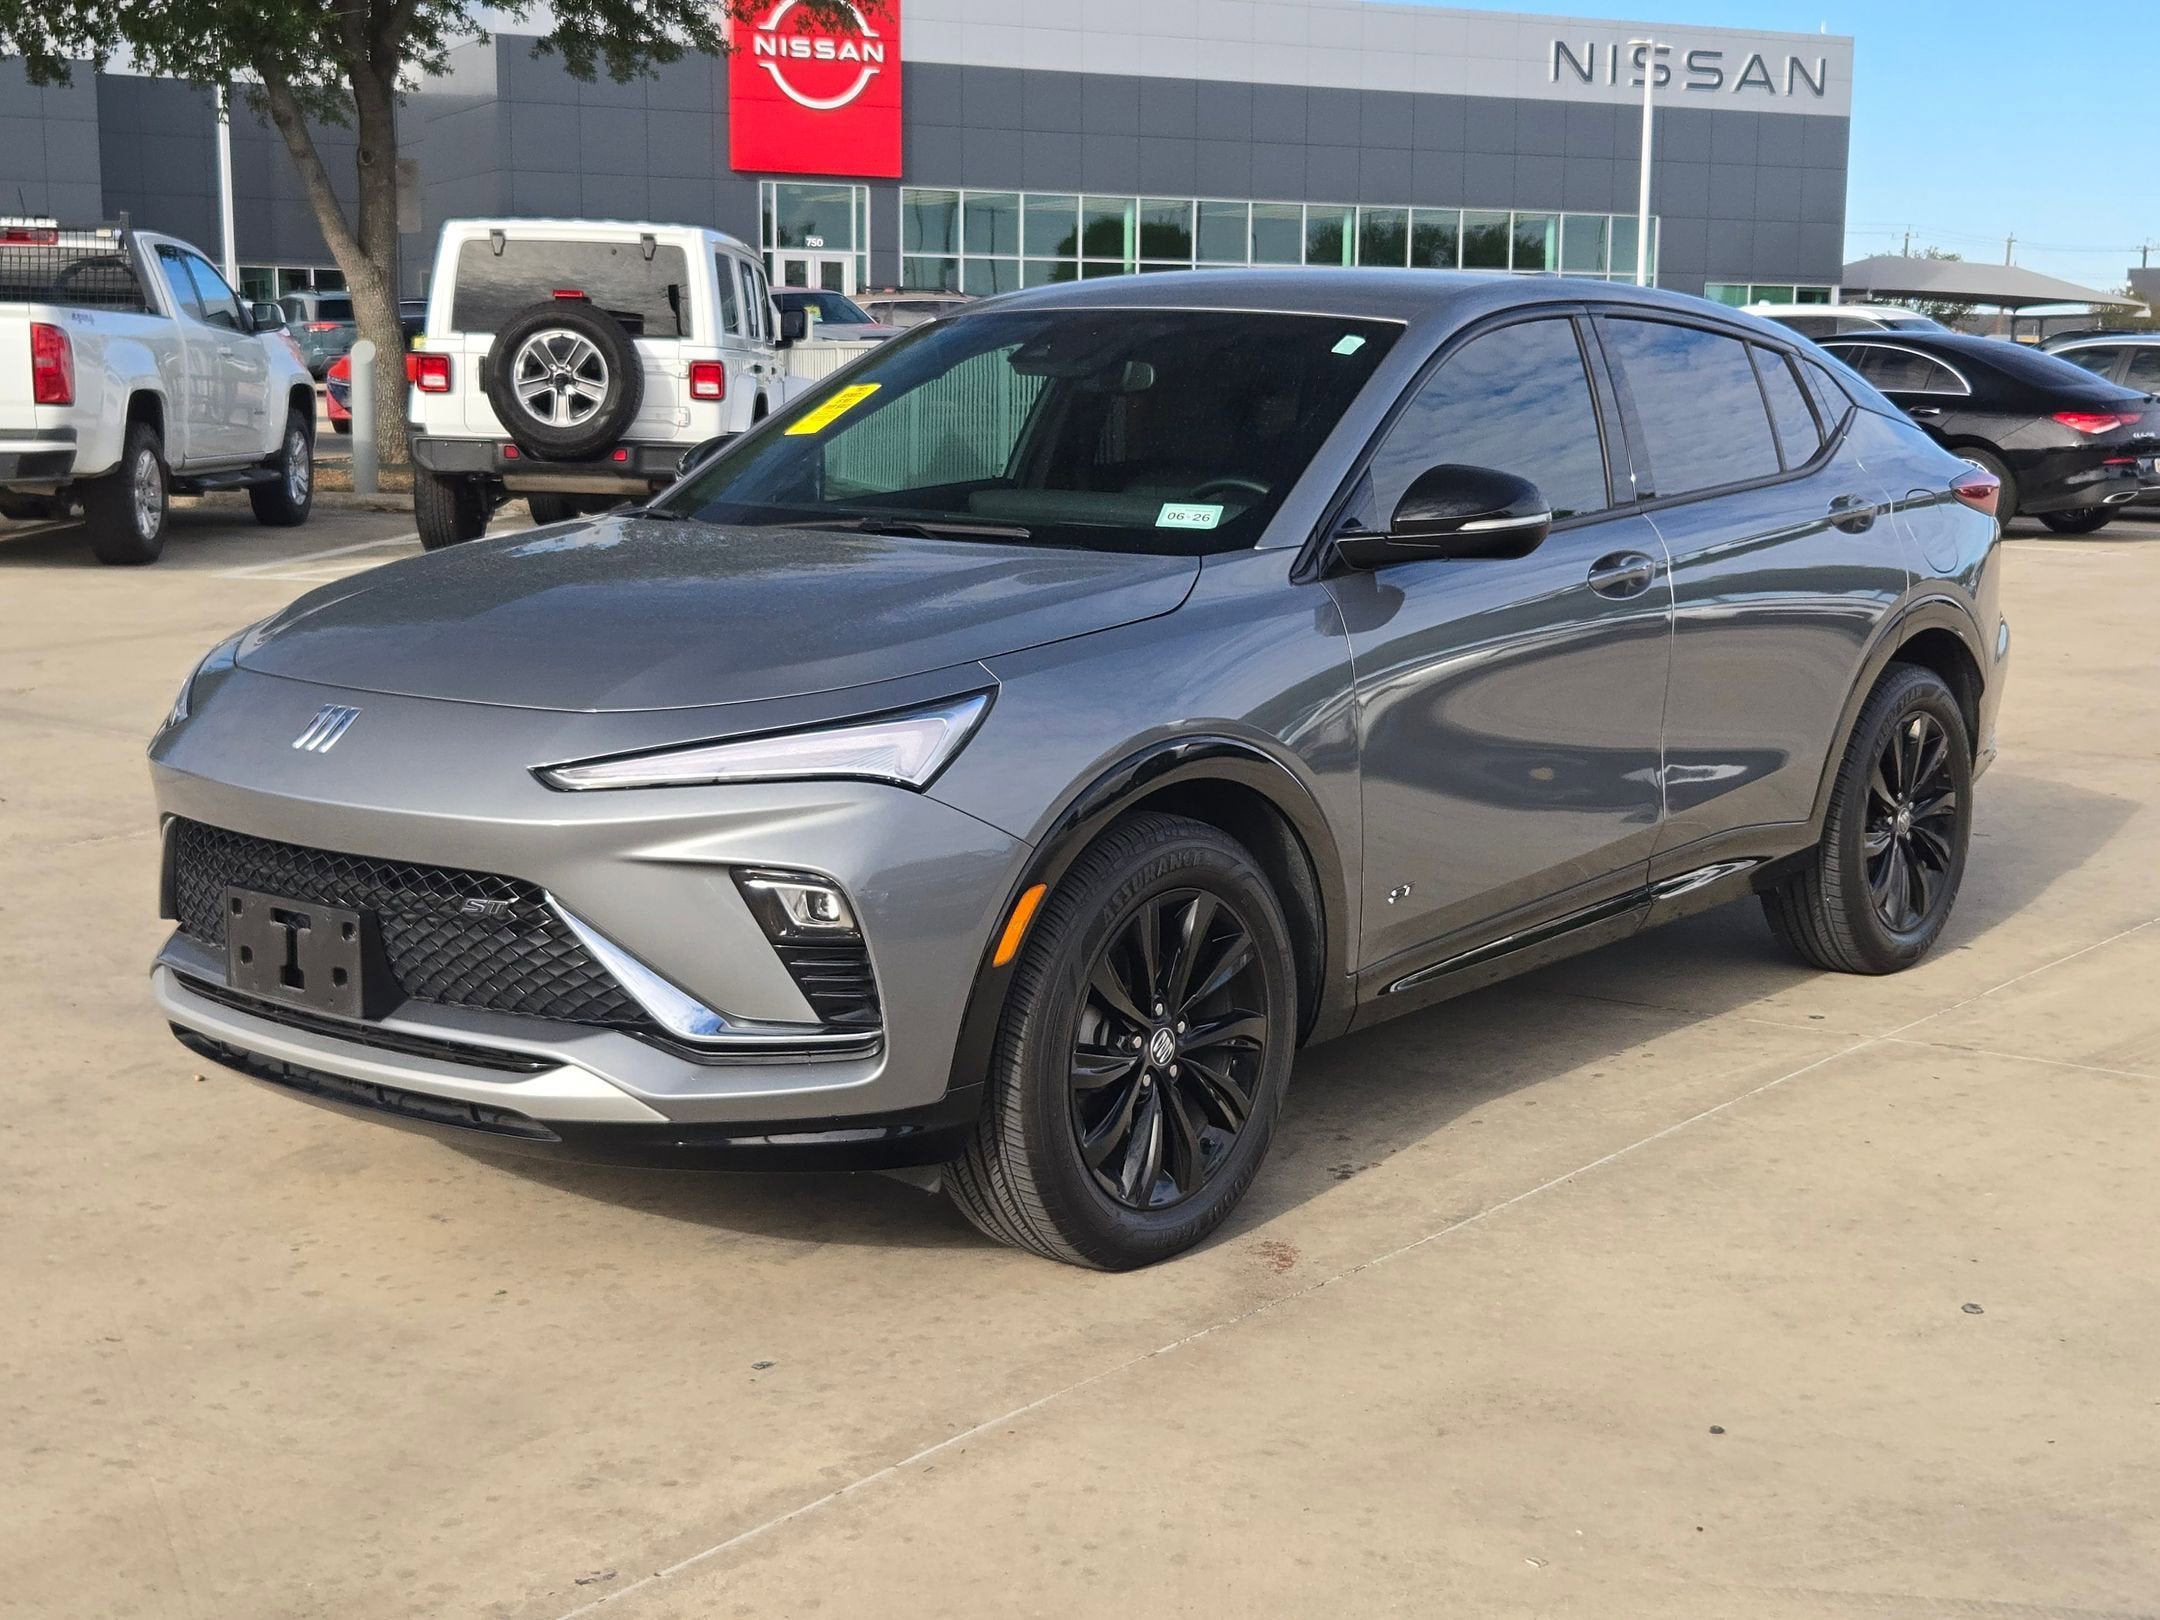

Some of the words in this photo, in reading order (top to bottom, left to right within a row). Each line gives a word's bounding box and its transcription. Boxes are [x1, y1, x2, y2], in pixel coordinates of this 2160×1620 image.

[753, 34, 884, 63] NISSAN
[1551, 39, 1827, 98] NISSAN
[805, 236, 824, 247] 750
[461, 898, 509, 914] ST
